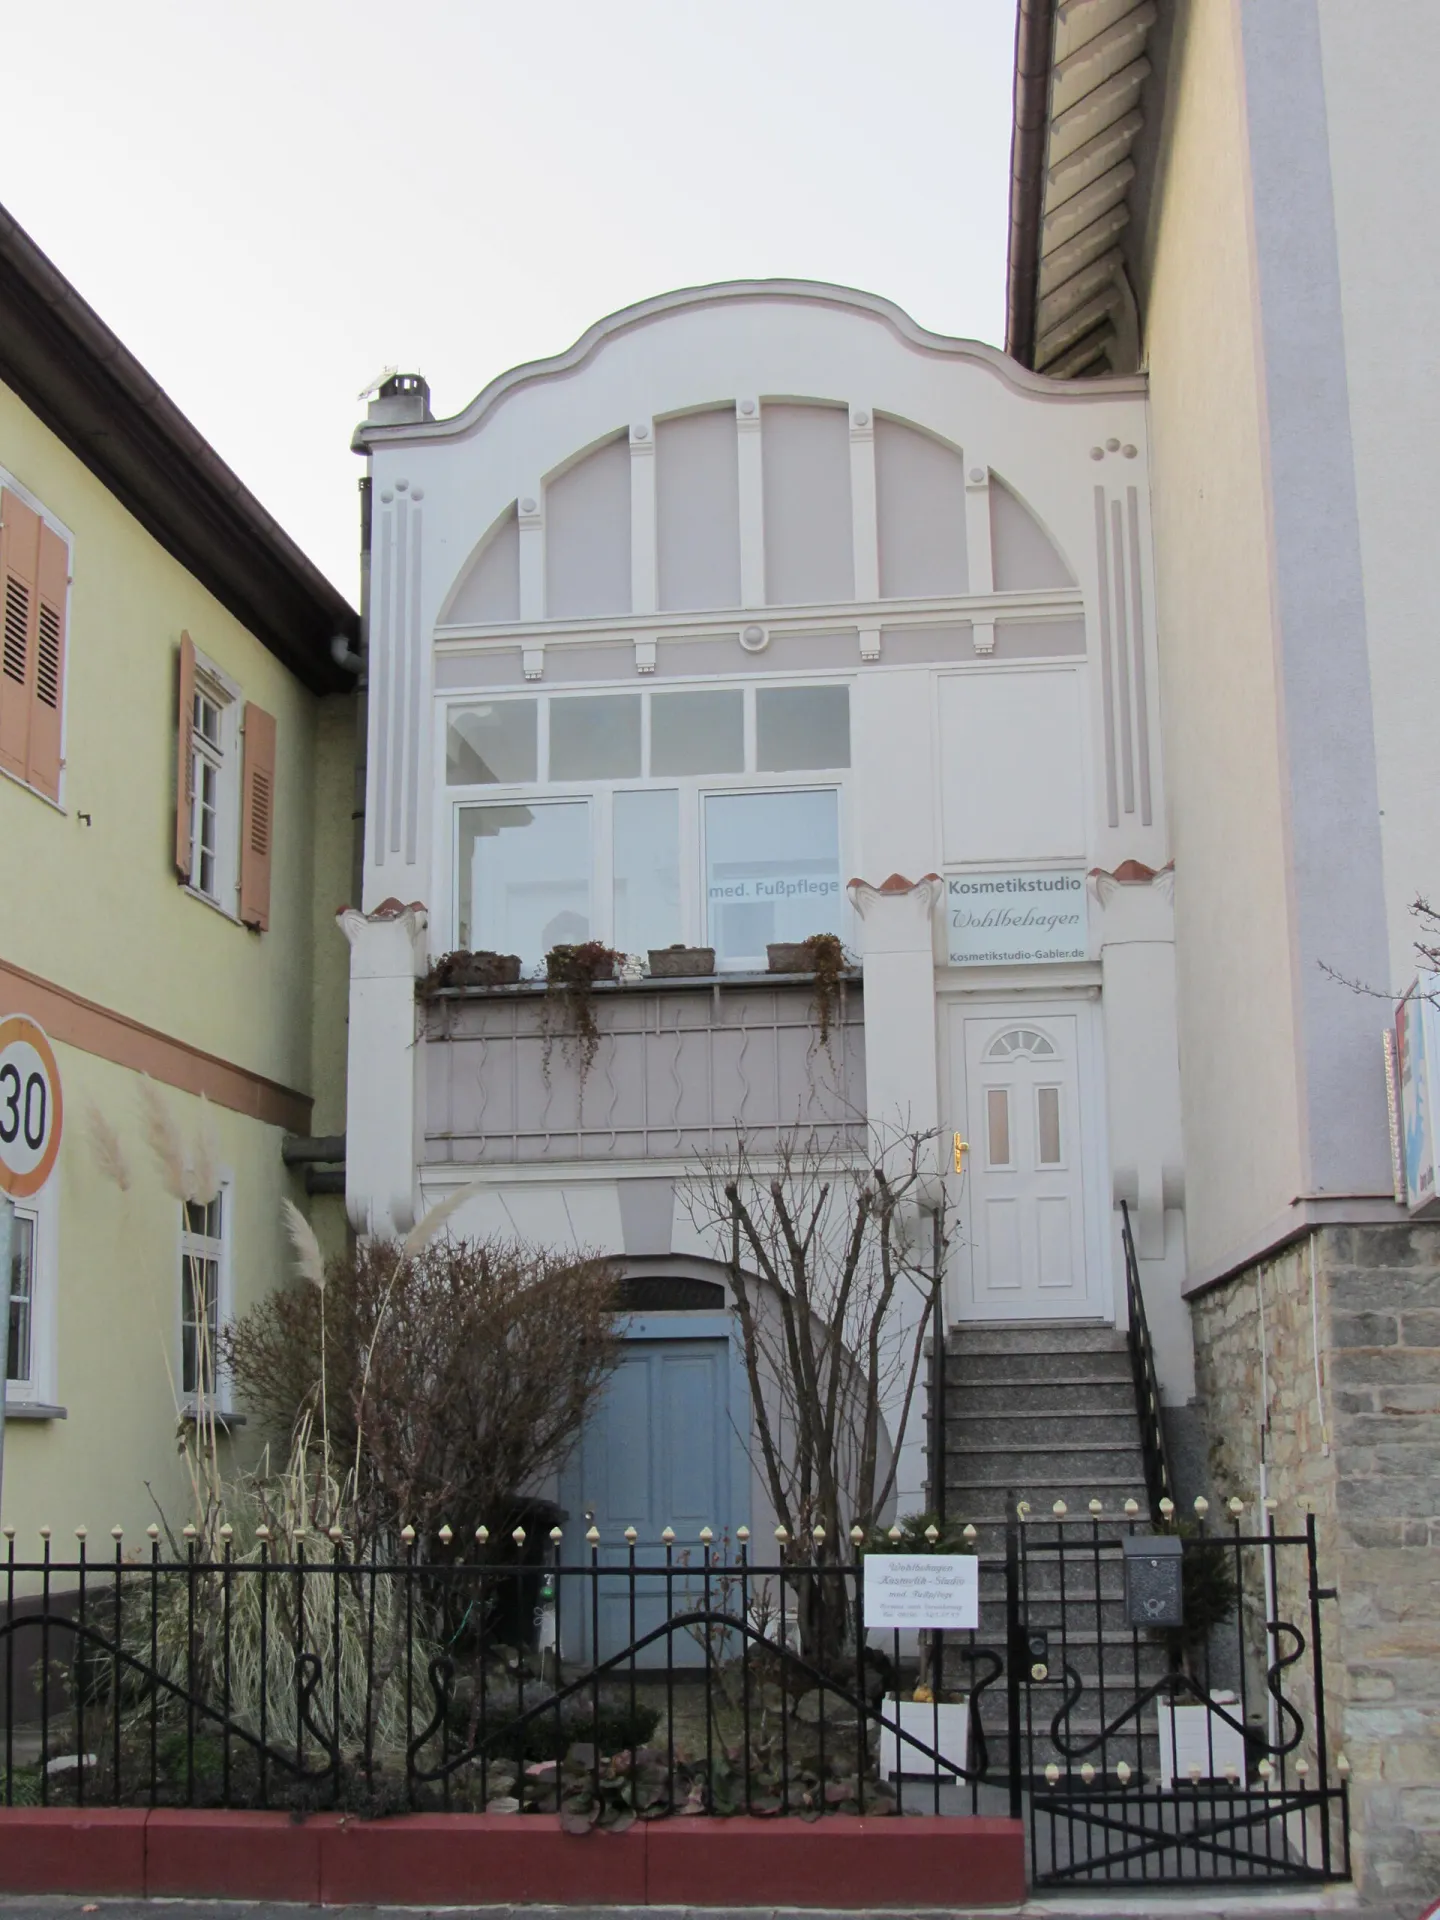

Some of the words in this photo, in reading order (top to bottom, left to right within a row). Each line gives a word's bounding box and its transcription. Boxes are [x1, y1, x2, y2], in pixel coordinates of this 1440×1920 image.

[709, 883, 750, 898] med.
[755, 879, 839, 897] Fußpflege
[949, 876, 1082, 895] Kosmetikstudio
[951, 907, 1080, 933] Wohlbehagen
[949, 948, 1085, 962] Kosmetikstudio-Gabler.de
[0, 1063, 46, 1150] 30
